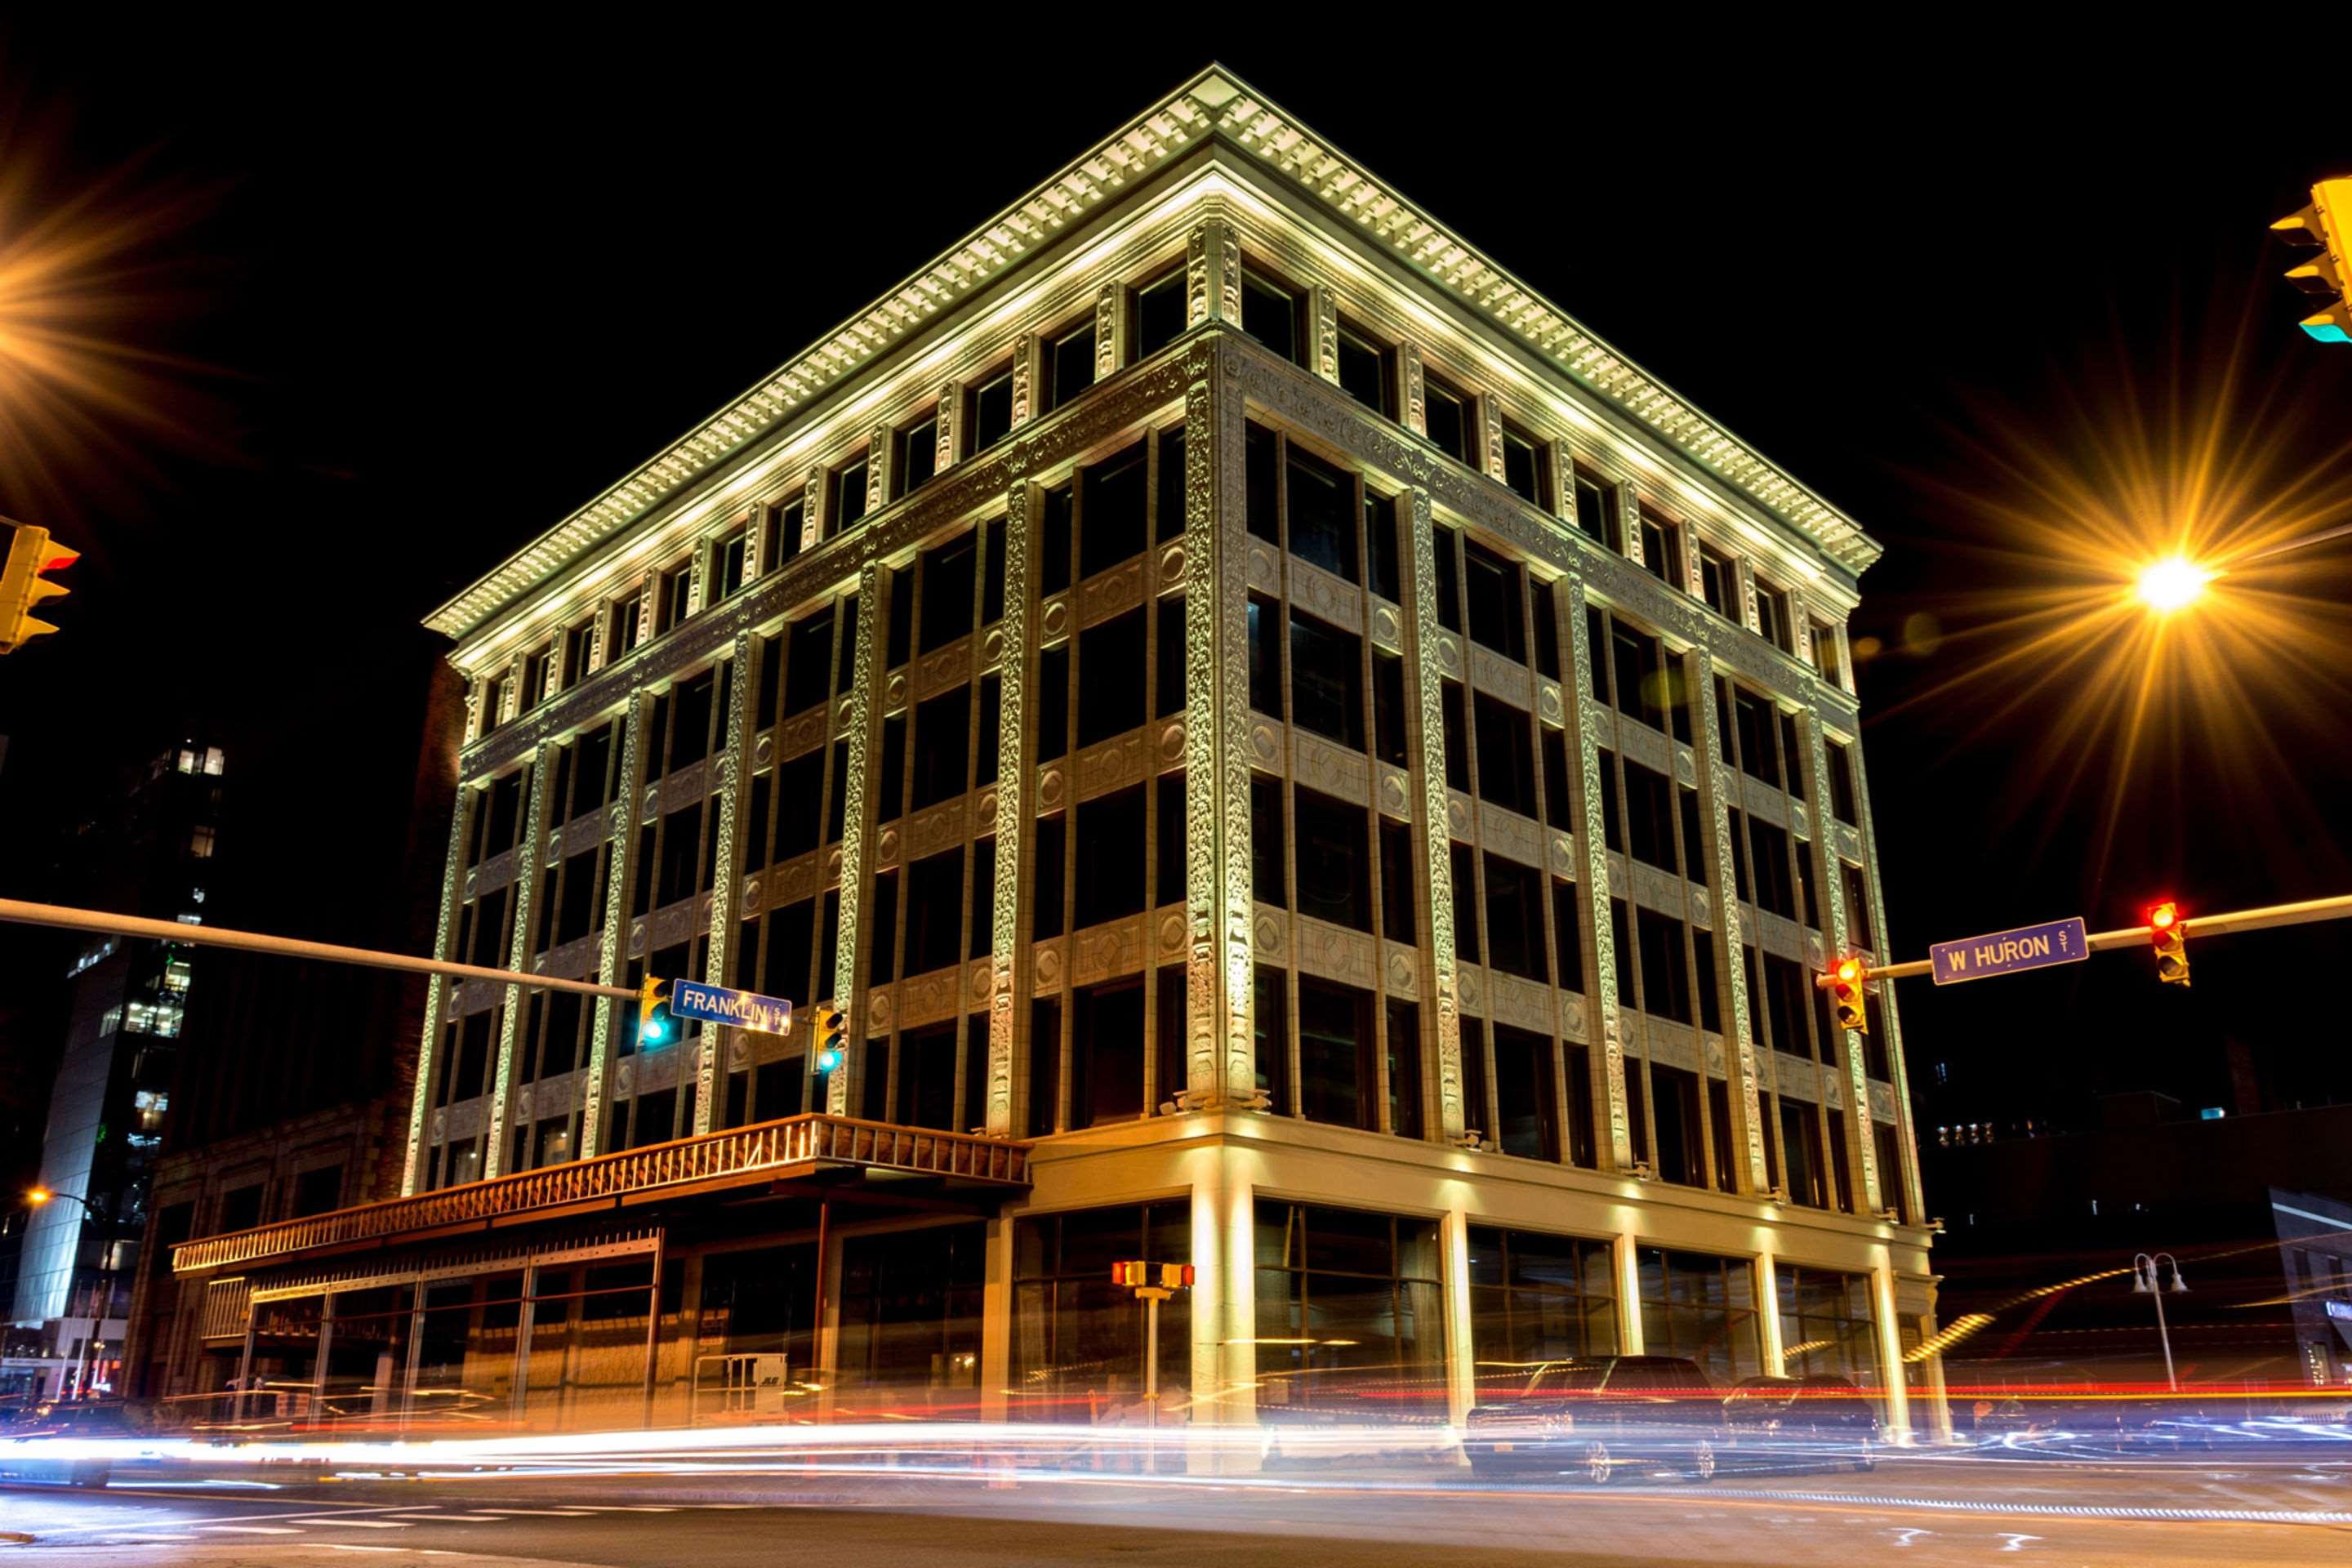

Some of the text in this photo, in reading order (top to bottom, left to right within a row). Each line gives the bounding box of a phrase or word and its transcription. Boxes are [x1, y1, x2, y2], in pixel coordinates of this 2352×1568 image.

[1948, 930, 2068, 972] W HURON ST
[683, 989, 768, 1022] FRANKLIN
